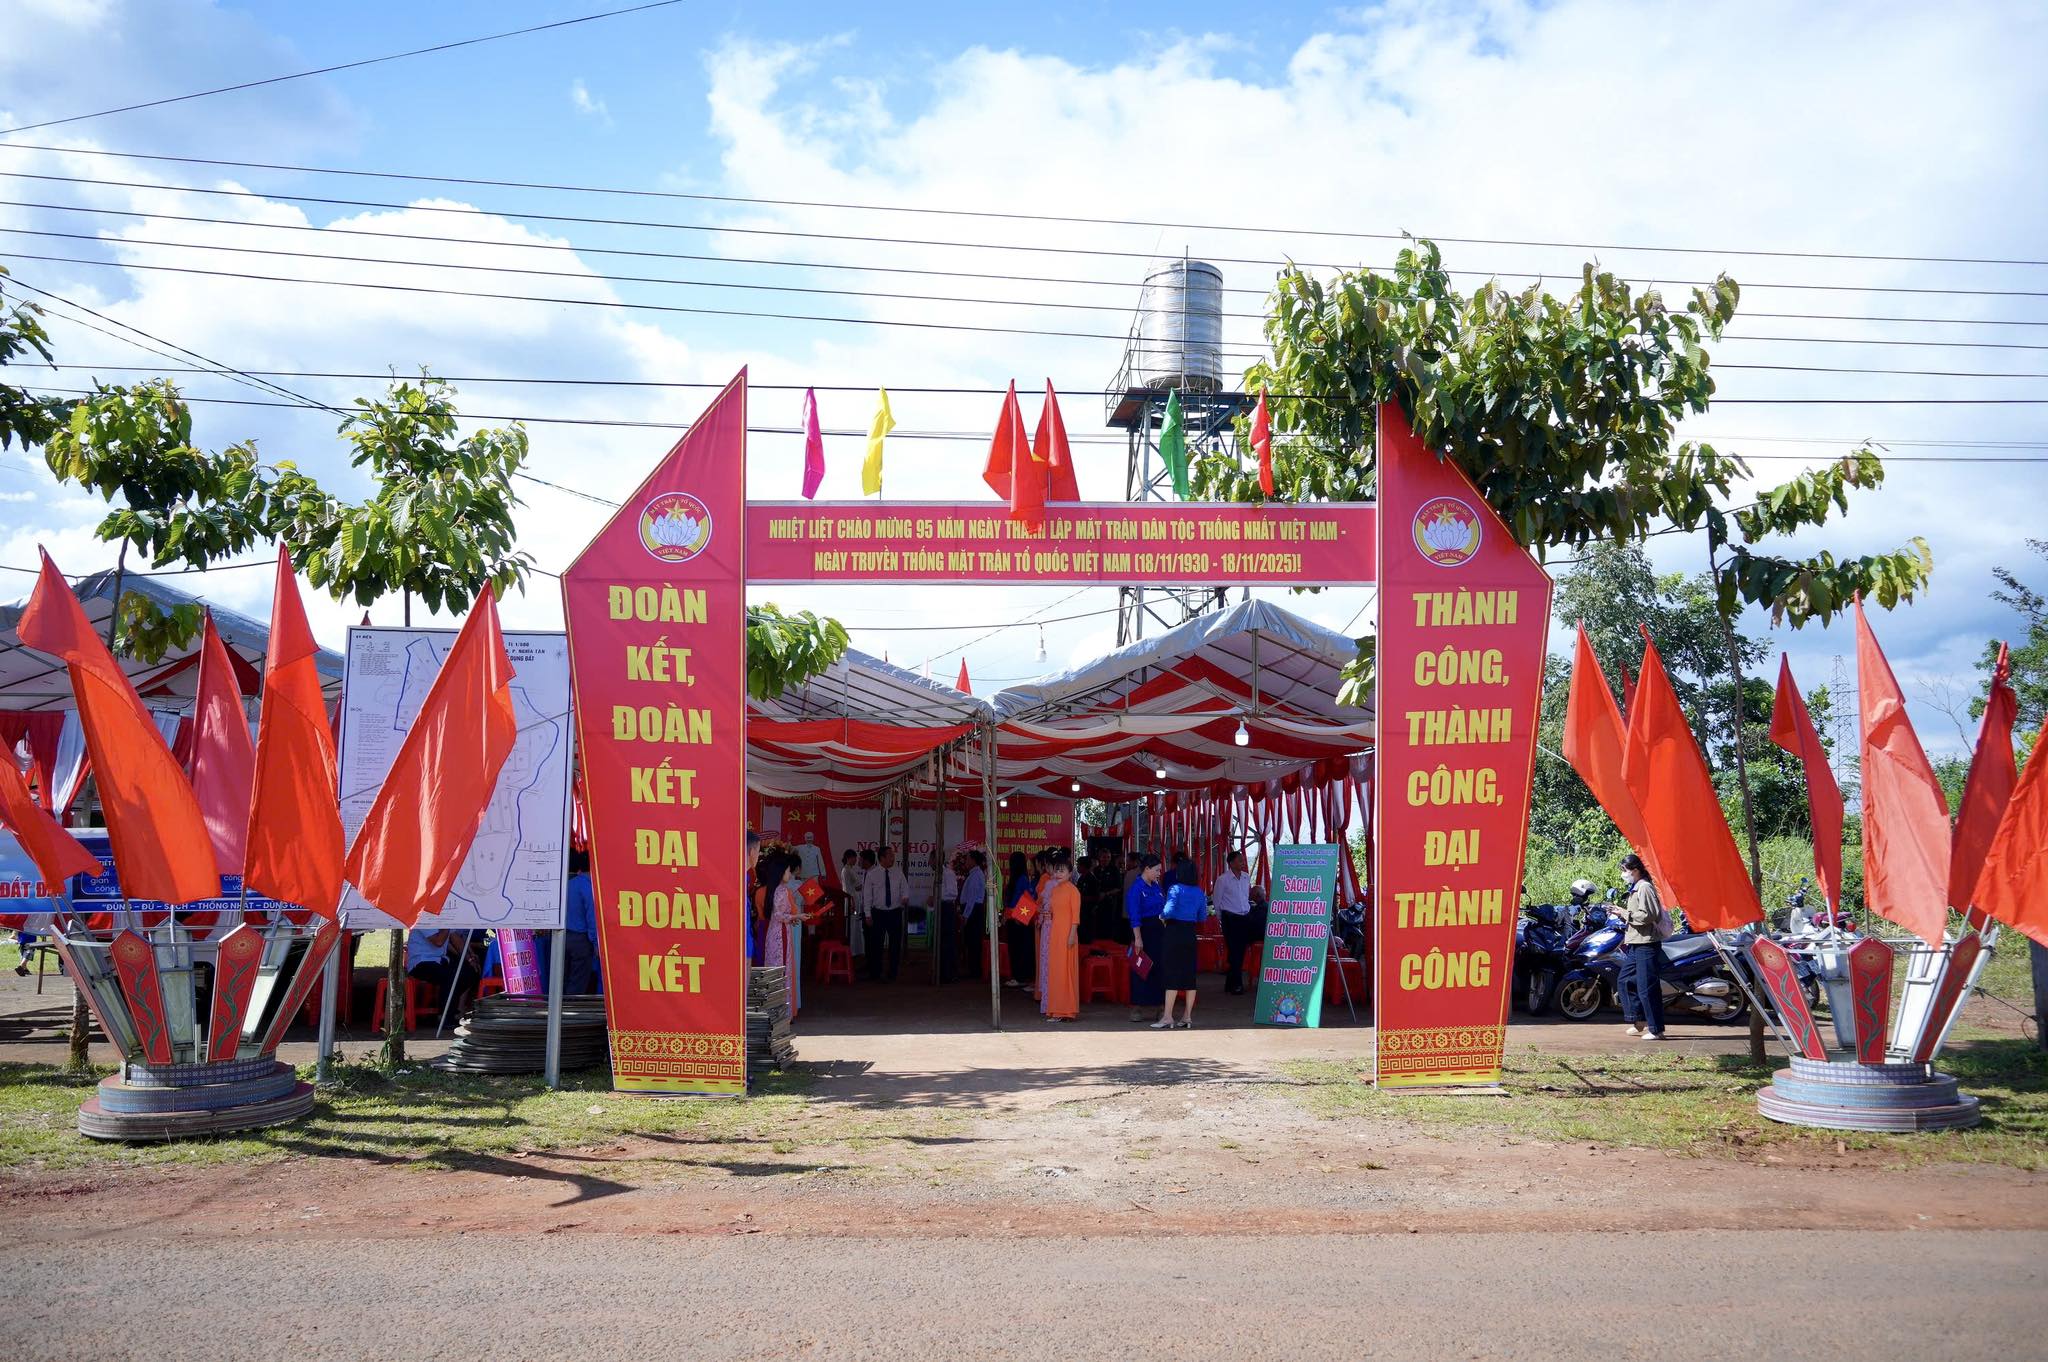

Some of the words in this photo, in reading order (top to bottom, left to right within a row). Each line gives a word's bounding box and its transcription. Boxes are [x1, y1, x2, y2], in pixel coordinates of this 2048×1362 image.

[769, 516, 805, 542] NHIỆT
[809, 516, 833, 542] LIỆT
[837, 516, 871, 539] CHÀO
[875, 516, 913, 539] MỪNG
[916, 519, 933, 539] 95
[937, 515, 964, 539] NĂM
[968, 516, 1001, 539] NGÀY
[1050, 517, 1072, 543] LẬP
[1076, 517, 1102, 543] MẶT
[1106, 517, 1138, 544] TRẬN
[1141, 517, 1167, 540] DÂN
[1170, 517, 1195, 544] TỘC
[1198, 515, 1240, 541] THỐNG
[1243, 515, 1276, 541] NHẤT
[1279, 518, 1306, 544] VIỆT
[1310, 521, 1338, 541] NAM
[814, 549, 848, 571] NGÀY
[851, 545, 898, 571] TRUYỀN
[902, 545, 944, 571] THỐNG
[948, 548, 975, 575] MẶT
[978, 549, 1011, 575] TRẬN
[1014, 546, 1030, 572] TỔ
[1034, 547, 1069, 574] QUỐC
[1072, 549, 1100, 576] VIỆT
[1103, 553, 1131, 573] NAM
[1134, 553, 1209, 573] (18/11/1930
[1221, 553, 1302, 573] 18/11/2025)!
[608, 583, 708, 624] ĐOÀN
[1413, 586, 1518, 627] THÀNH
[626, 636, 695, 687] KẾT,
[1414, 645, 1510, 687] CÔNG,
[612, 702, 713, 745] ĐOÀN
[1405, 704, 1512, 746] THÀNH
[631, 756, 700, 809] KẾT,
[1407, 763, 1503, 806] CÔNG,
[635, 829, 699, 873] ĐẠI
[1424, 829, 1480, 871] ĐẠI
[0, 875, 31, 898] ĐẤT
[1310, 876, 1322, 892] LÀ
[618, 887, 720, 930] ĐOÀN
[1271, 900, 1290, 915] CON
[1394, 886, 1503, 928] THÀNH
[1287, 923, 1302, 937] TRI
[1303, 921, 1327, 938] THỨC
[638, 944, 705, 993] KẾT
[1273, 941, 1292, 960] ĐẾN
[1294, 946, 1312, 961] CHO
[1400, 947, 1491, 990] CÔNG
[1264, 967, 1282, 985] MỌI
